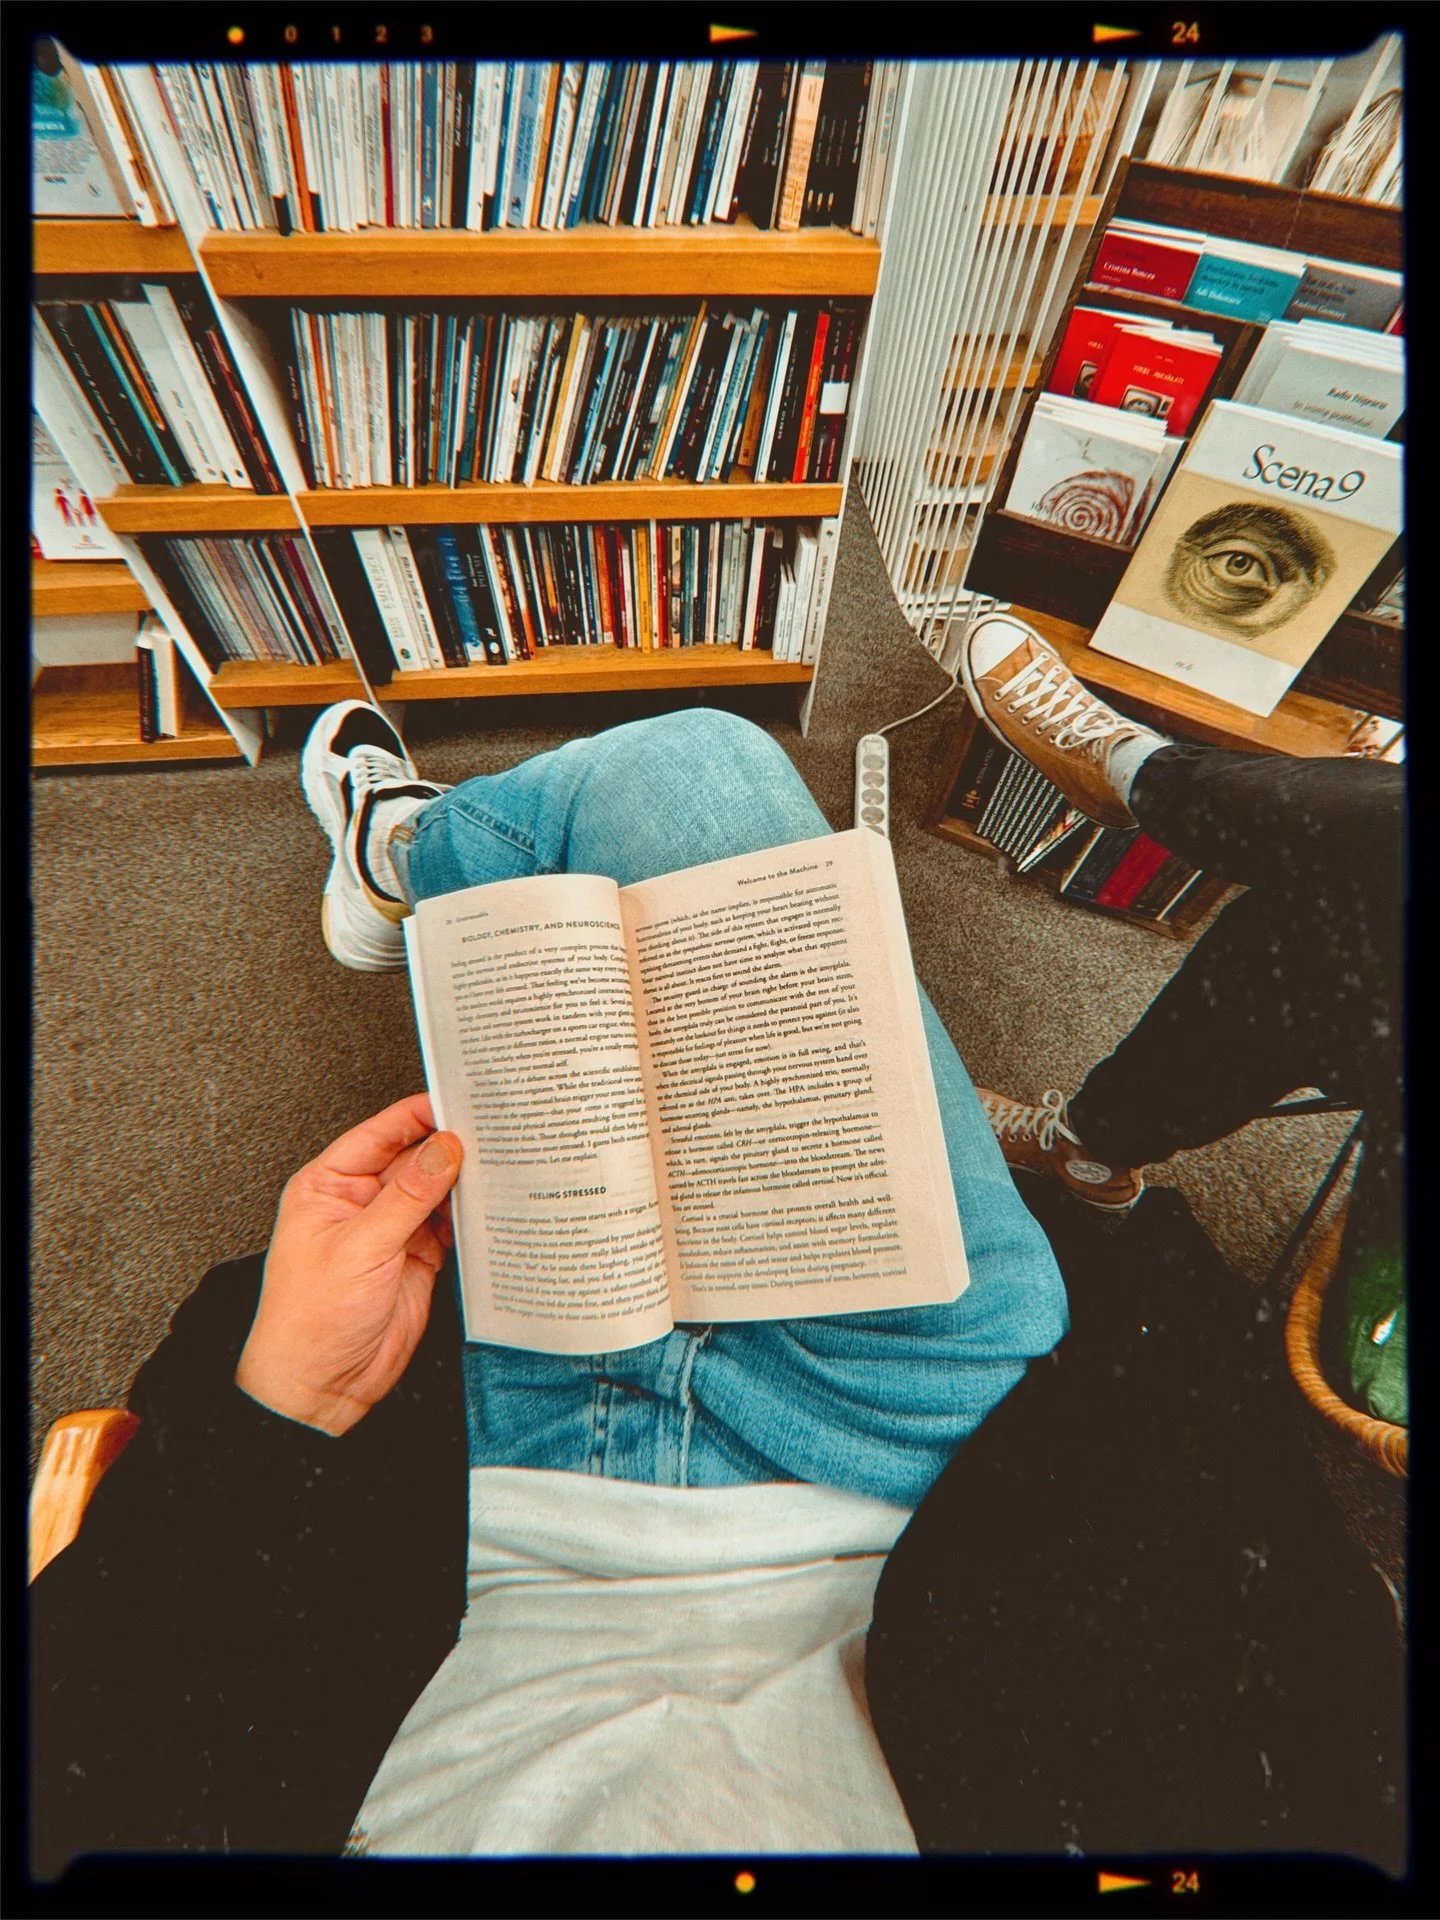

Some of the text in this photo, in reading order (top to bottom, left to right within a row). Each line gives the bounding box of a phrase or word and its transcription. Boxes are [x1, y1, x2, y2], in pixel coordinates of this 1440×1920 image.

[1242, 443, 1366, 502] Scena9
[737, 876, 766, 886] Welcome
[789, 865, 818, 874] Machine
[732, 894, 839, 920] keeping your heart beating without
[711, 928, 722, 936] side
[723, 925, 730, 933] of
[731, 924, 743, 932] this
[744, 921, 765, 930] system
[766, 917, 779, 925] that
[780, 913, 804, 922] engages
[813, 904, 841, 915] normally
[757, 928, 776, 937] which
[784, 921, 811, 932] activated
[812, 919, 830, 928] upon
[462, 932, 493, 943] BIOLOGY,
[494, 924, 542, 937] CHEMISTRY,
[797, 933, 815, 941] freeze
[763, 950, 786, 959] analyze
[819, 939, 847, 950] apparent
[732, 966, 751, 976] sound
[768, 973, 779, 981] the
[780, 971, 798, 979] alarm
[807, 966, 818, 974] the
[819, 960, 851, 972] amygdala.
[530, 981, 545, 989] That
[546, 979, 568, 987] feeling
[728, 992, 742, 1001] your
[744, 989, 761, 997] brain
[762, 985, 777, 994] right
[778, 982, 798, 990] before
[800, 979, 815, 988] your
[816, 976, 834, 984] brain
[735, 1010, 767, 1021] considered
[780, 1002, 808, 1015] paranoid
[809, 1001, 822, 1010] part
[823, 997, 831, 1006] of
[832, 998, 846, 1006] you.
[848, 993, 858, 1002] It's
[535, 1014, 551, 1023] work
[562, 1012, 587, 1020] tandem
[723, 1037, 747, 1047] pleasure
[765, 1031, 776, 1039] life
[783, 1027, 801, 1038] good,
[843, 1018, 862, 1028] going
[725, 1058, 752, 1069] engaged,
[754, 1055, 780, 1064] emotion
[798, 1048, 809, 1057] full
[811, 1047, 832, 1055] swing,
[834, 1042, 847, 1051] and
[849, 1040, 866, 1049] that's
[724, 1072, 746, 1082] passing
[747, 1067, 771, 1076] through
[772, 1065, 787, 1074] your
[788, 1062, 813, 1070] nervous
[814, 1058, 835, 1067] system
[836, 1053, 853, 1063] hand
[556, 1077, 622, 1090] While the traditional
[719, 1085, 733, 1093] your
[734, 1081, 750, 1090] body.
[760, 1077, 780, 1087] highly
[782, 1070, 823, 1083] synchronized
[841, 1063, 870, 1074] normally
[789, 1085, 805, 1093] HPA
[807, 1081, 834, 1090] includes
[843, 1078, 862, 1087] group
[864, 1074, 872, 1083] of
[789, 1121, 810, 1130] trigger
[811, 1118, 822, 1126] the
[823, 1113, 869, 1125] hypothalamus
[801, 1143, 822, 1151] secrete
[831, 1138, 861, 1147] hormone
[863, 1133, 883, 1143] called
[770, 1171, 780, 1179] the
[781, 1168, 821, 1177] bloodstream
[831, 1163, 856, 1174] prompt
[857, 1160, 868, 1168] the
[836, 1175, 853, 1183] Now
[529, 1186, 606, 1200] FEELING STRESSED
[786, 1205, 812, 1215] protects
[814, 1200, 836, 1210] overall
[838, 1198, 859, 1207] health
[862, 1196, 875, 1205] and
